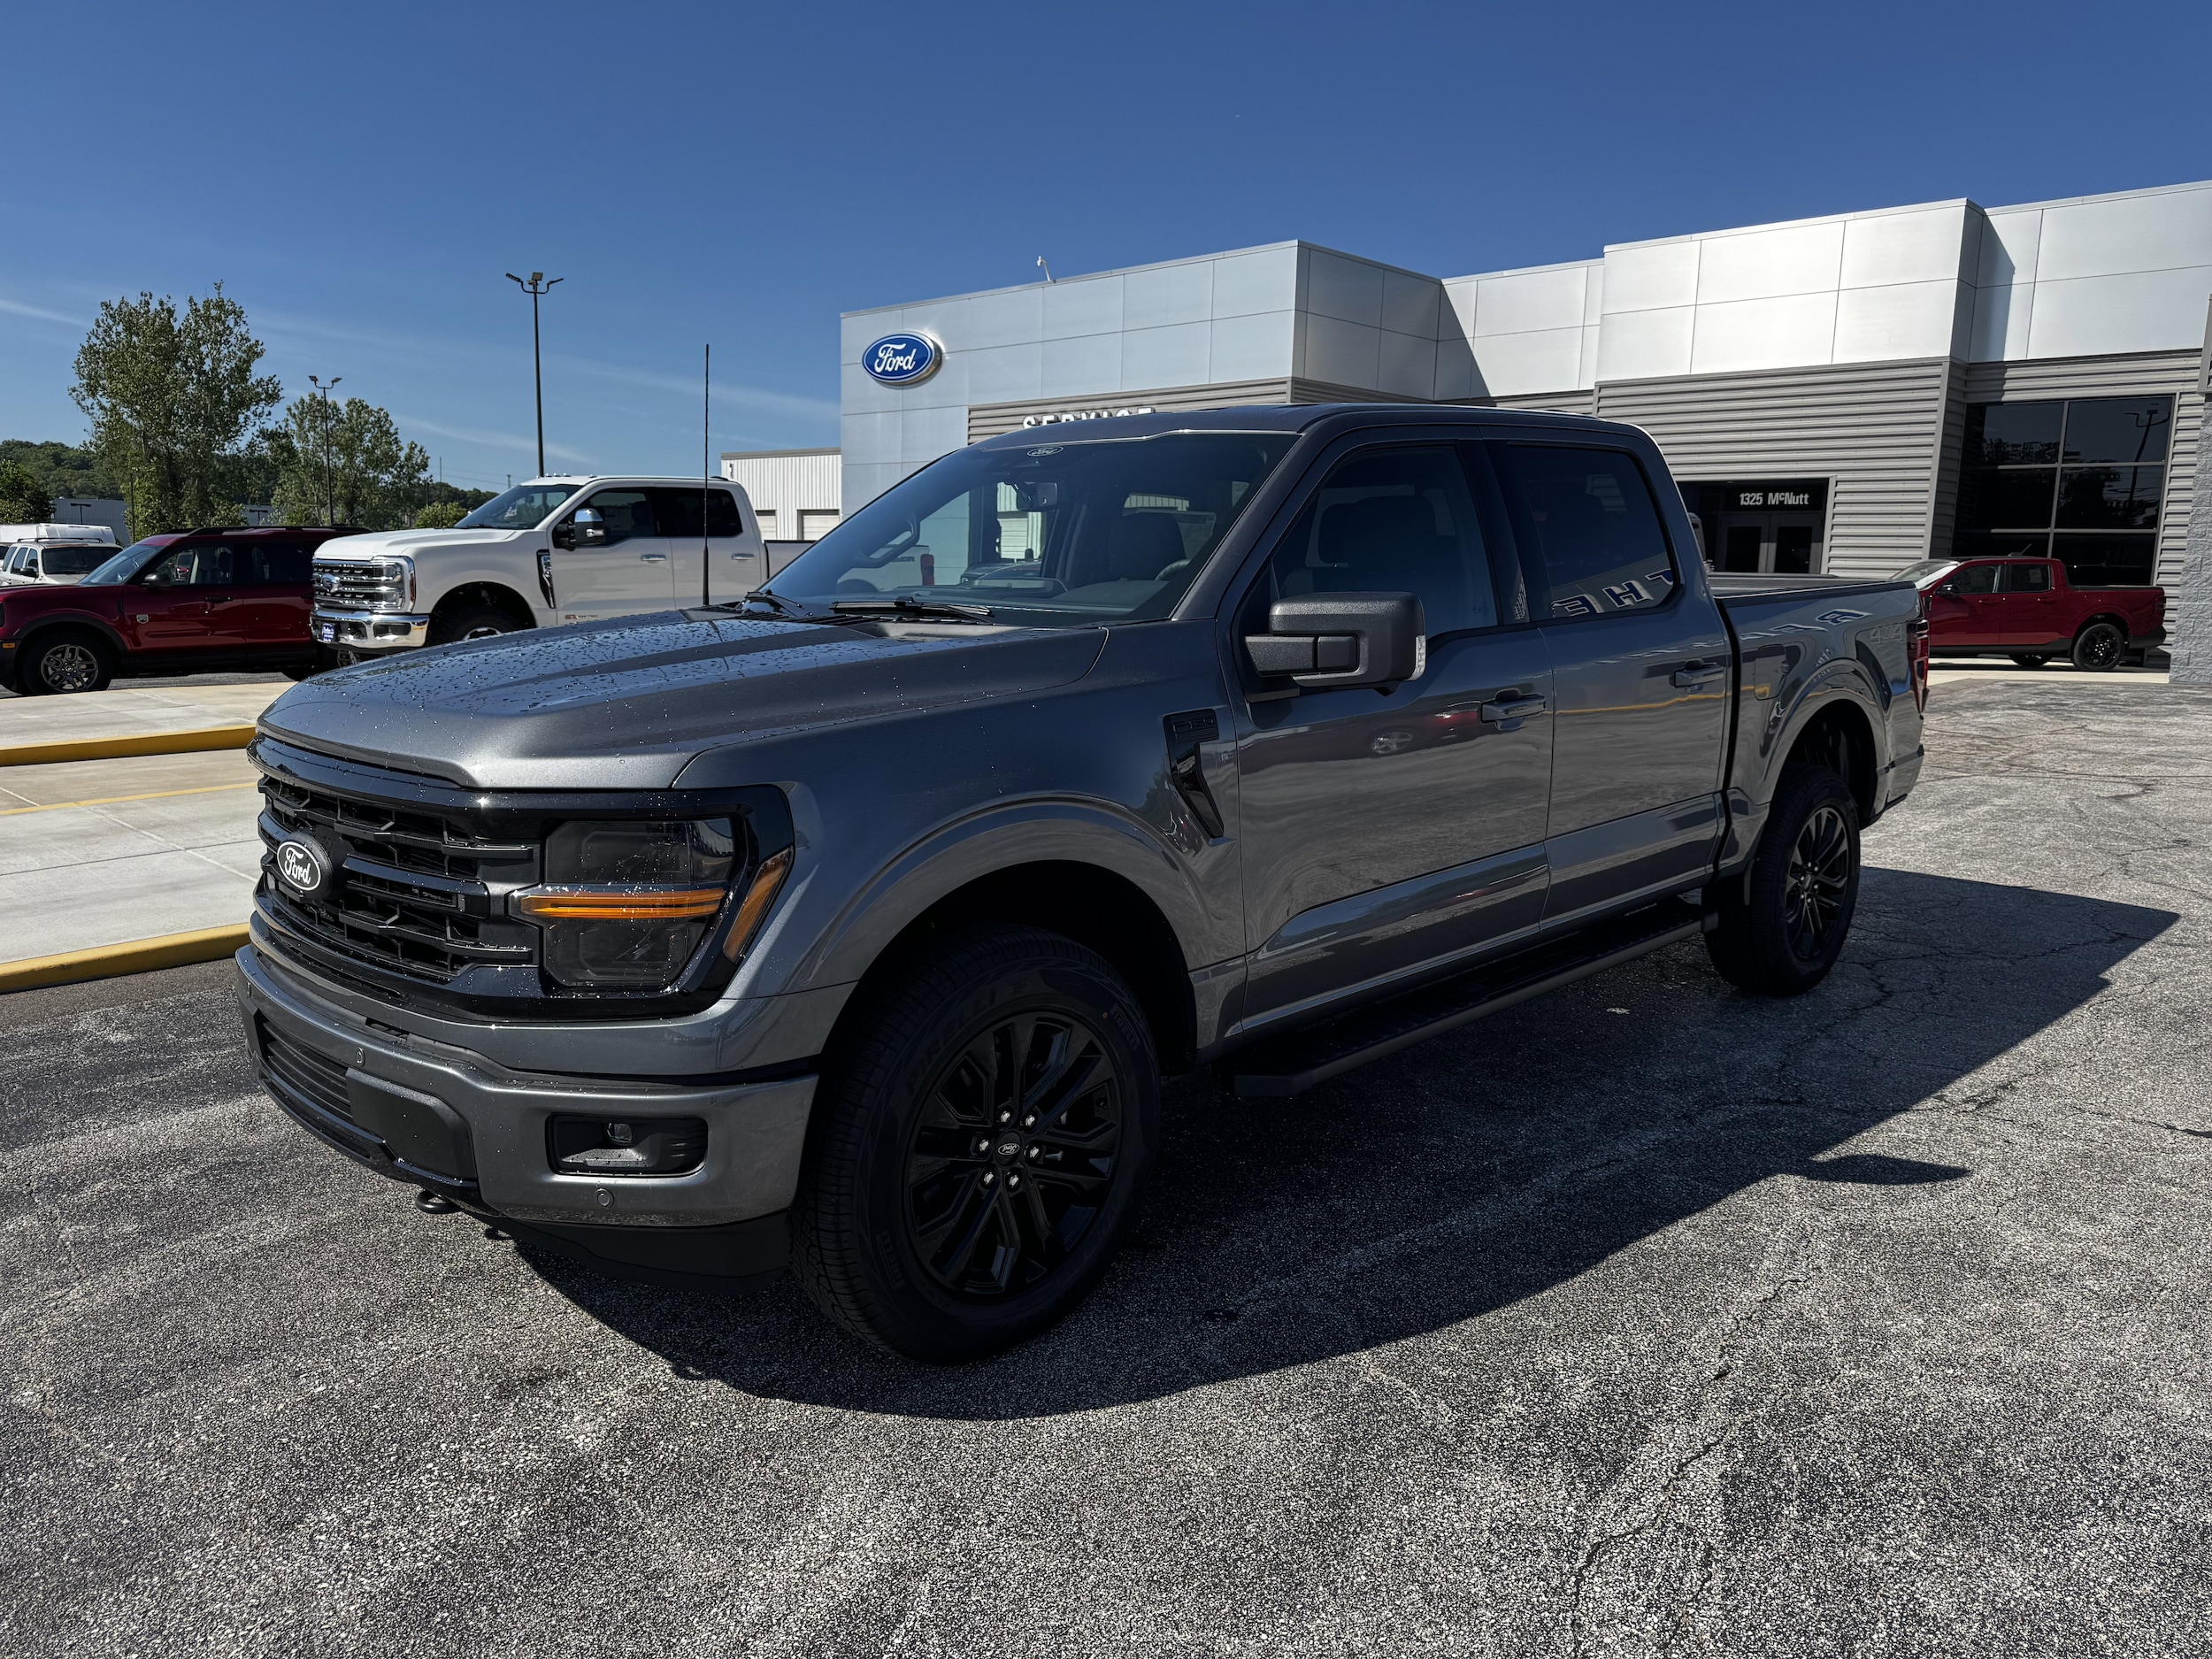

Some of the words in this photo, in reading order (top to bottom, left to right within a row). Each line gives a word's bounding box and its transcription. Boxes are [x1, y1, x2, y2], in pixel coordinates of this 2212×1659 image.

[874, 343, 917, 373] Ford
[1740, 493, 1763, 505] 1325
[1768, 492, 1809, 505] McNutt
[285, 847, 311, 885] Ford
